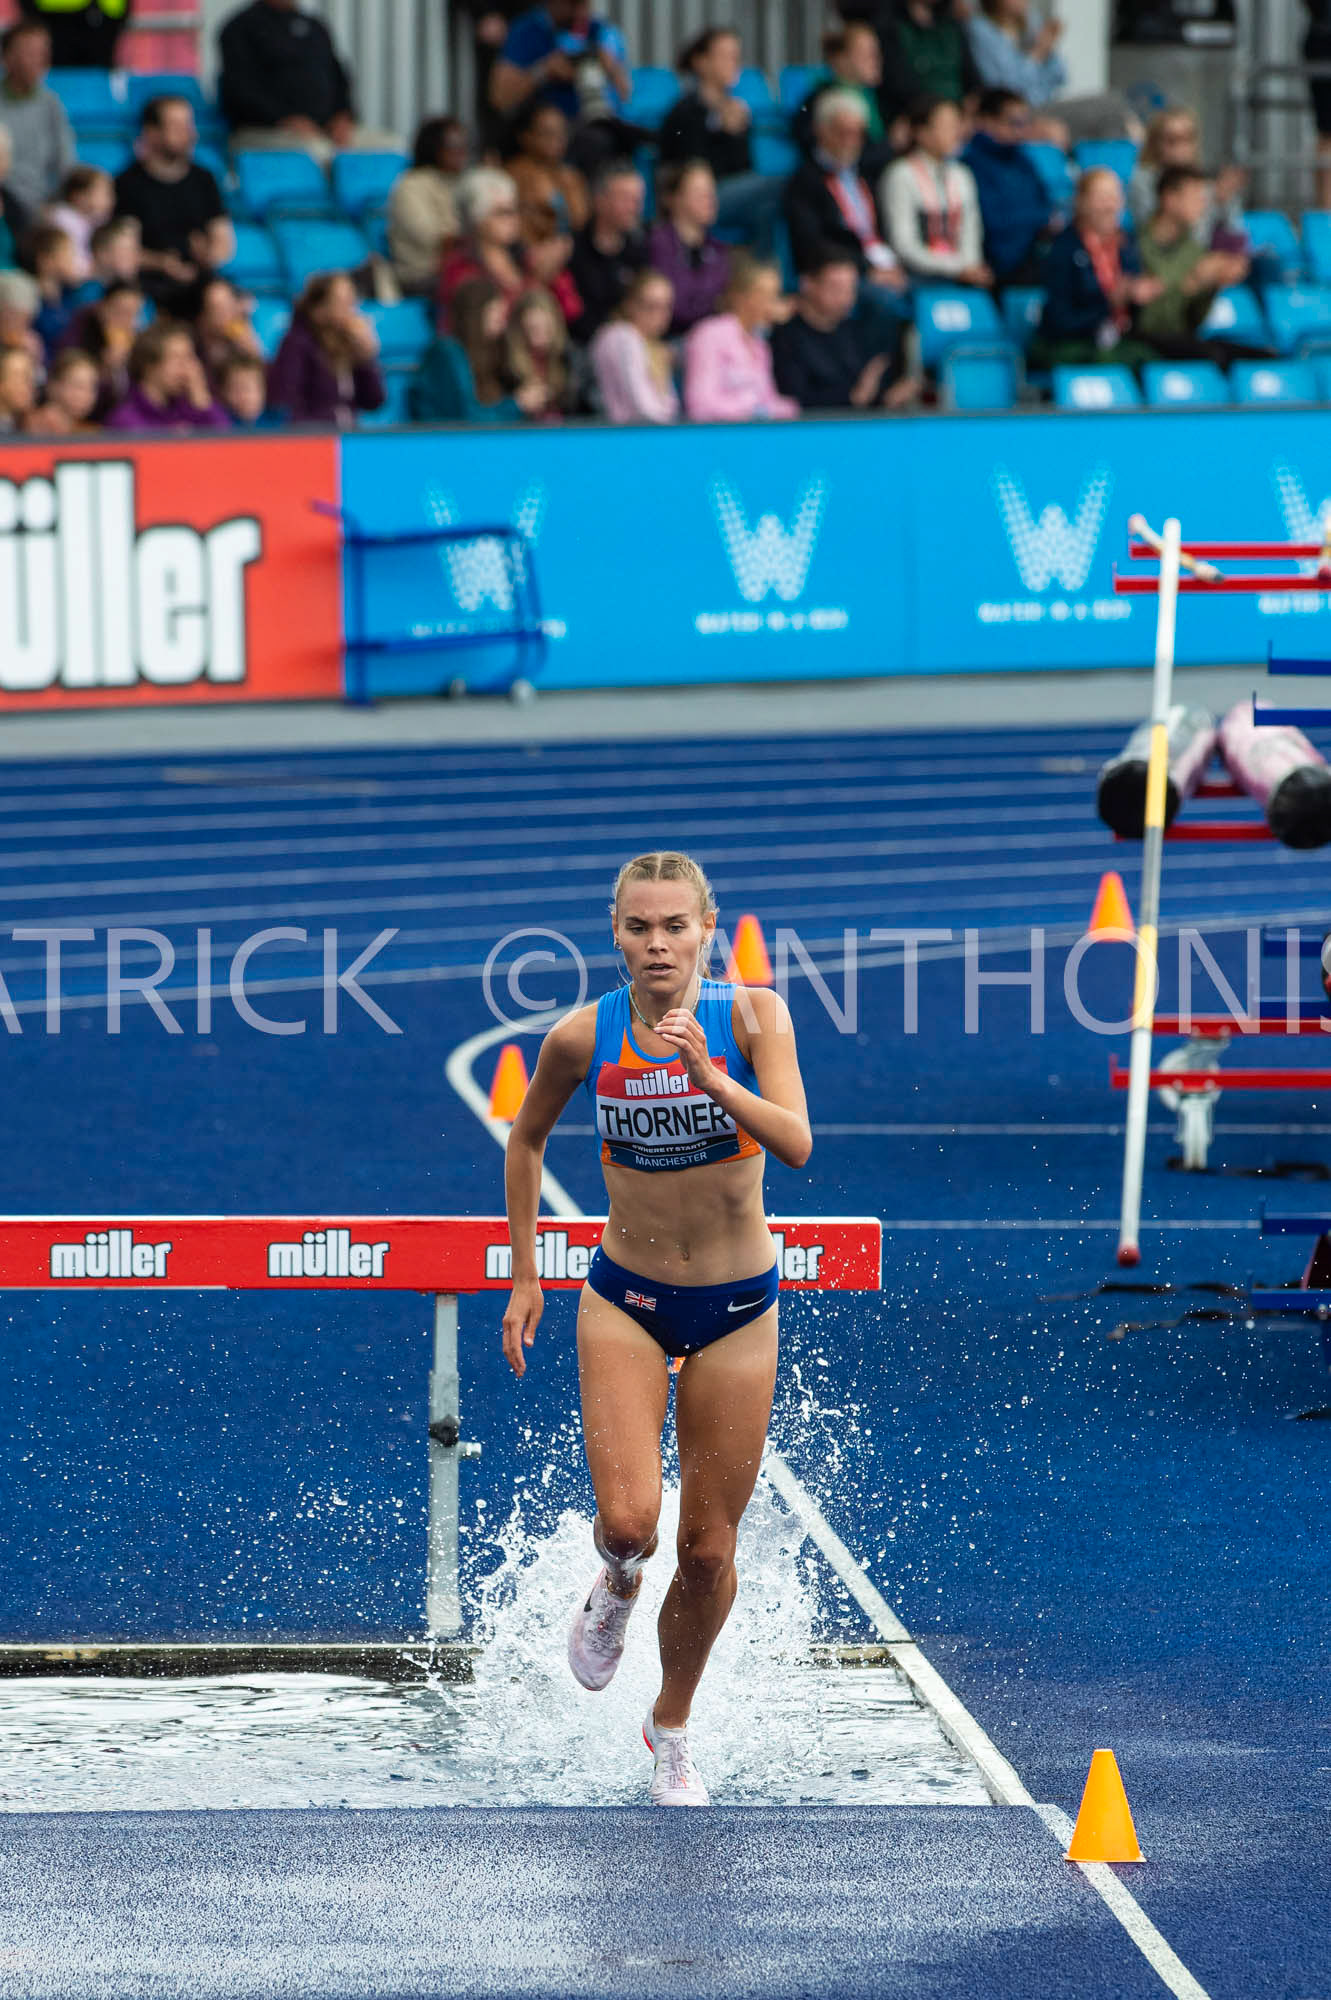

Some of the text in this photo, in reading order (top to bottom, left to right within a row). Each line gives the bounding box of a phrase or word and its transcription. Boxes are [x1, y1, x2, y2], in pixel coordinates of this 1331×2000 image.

[600, 1102, 731, 1137] THORNER
[635, 1151, 707, 1167] MANCHESTER
[50, 1228, 173, 1278] müller
[267, 1228, 391, 1278] müller
